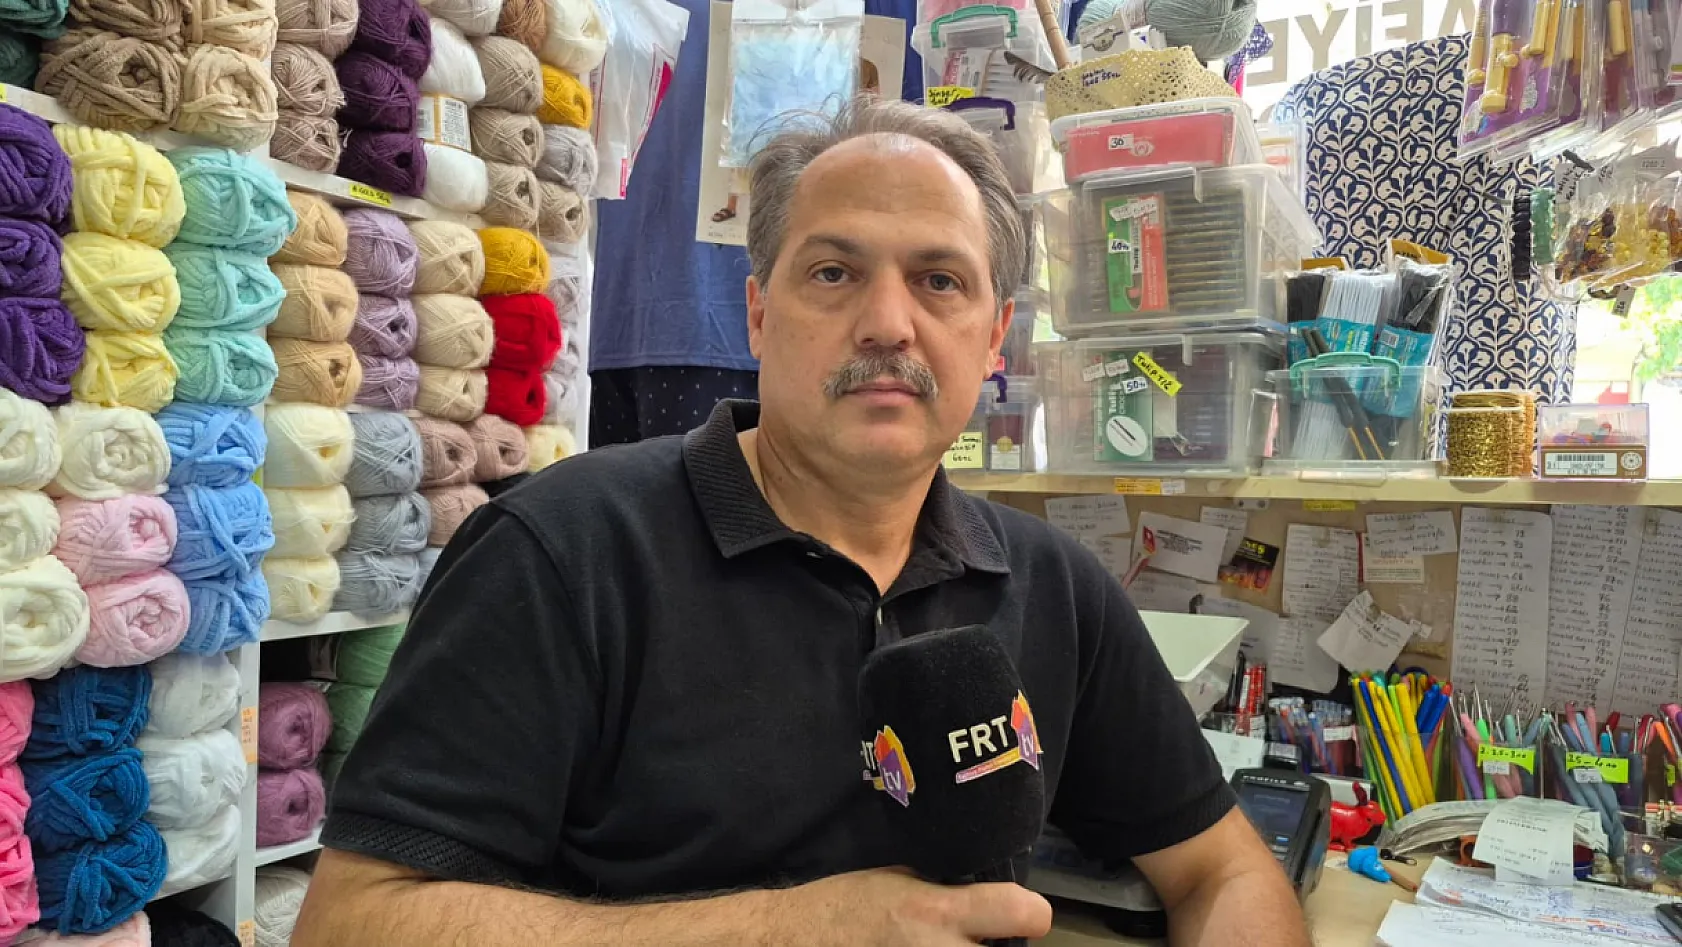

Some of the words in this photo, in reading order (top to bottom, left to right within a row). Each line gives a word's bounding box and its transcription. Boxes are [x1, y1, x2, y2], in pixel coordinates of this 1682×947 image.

[949, 715, 1008, 763] FRT
[1021, 733, 1034, 758] tv
[882, 770, 902, 792] tv
